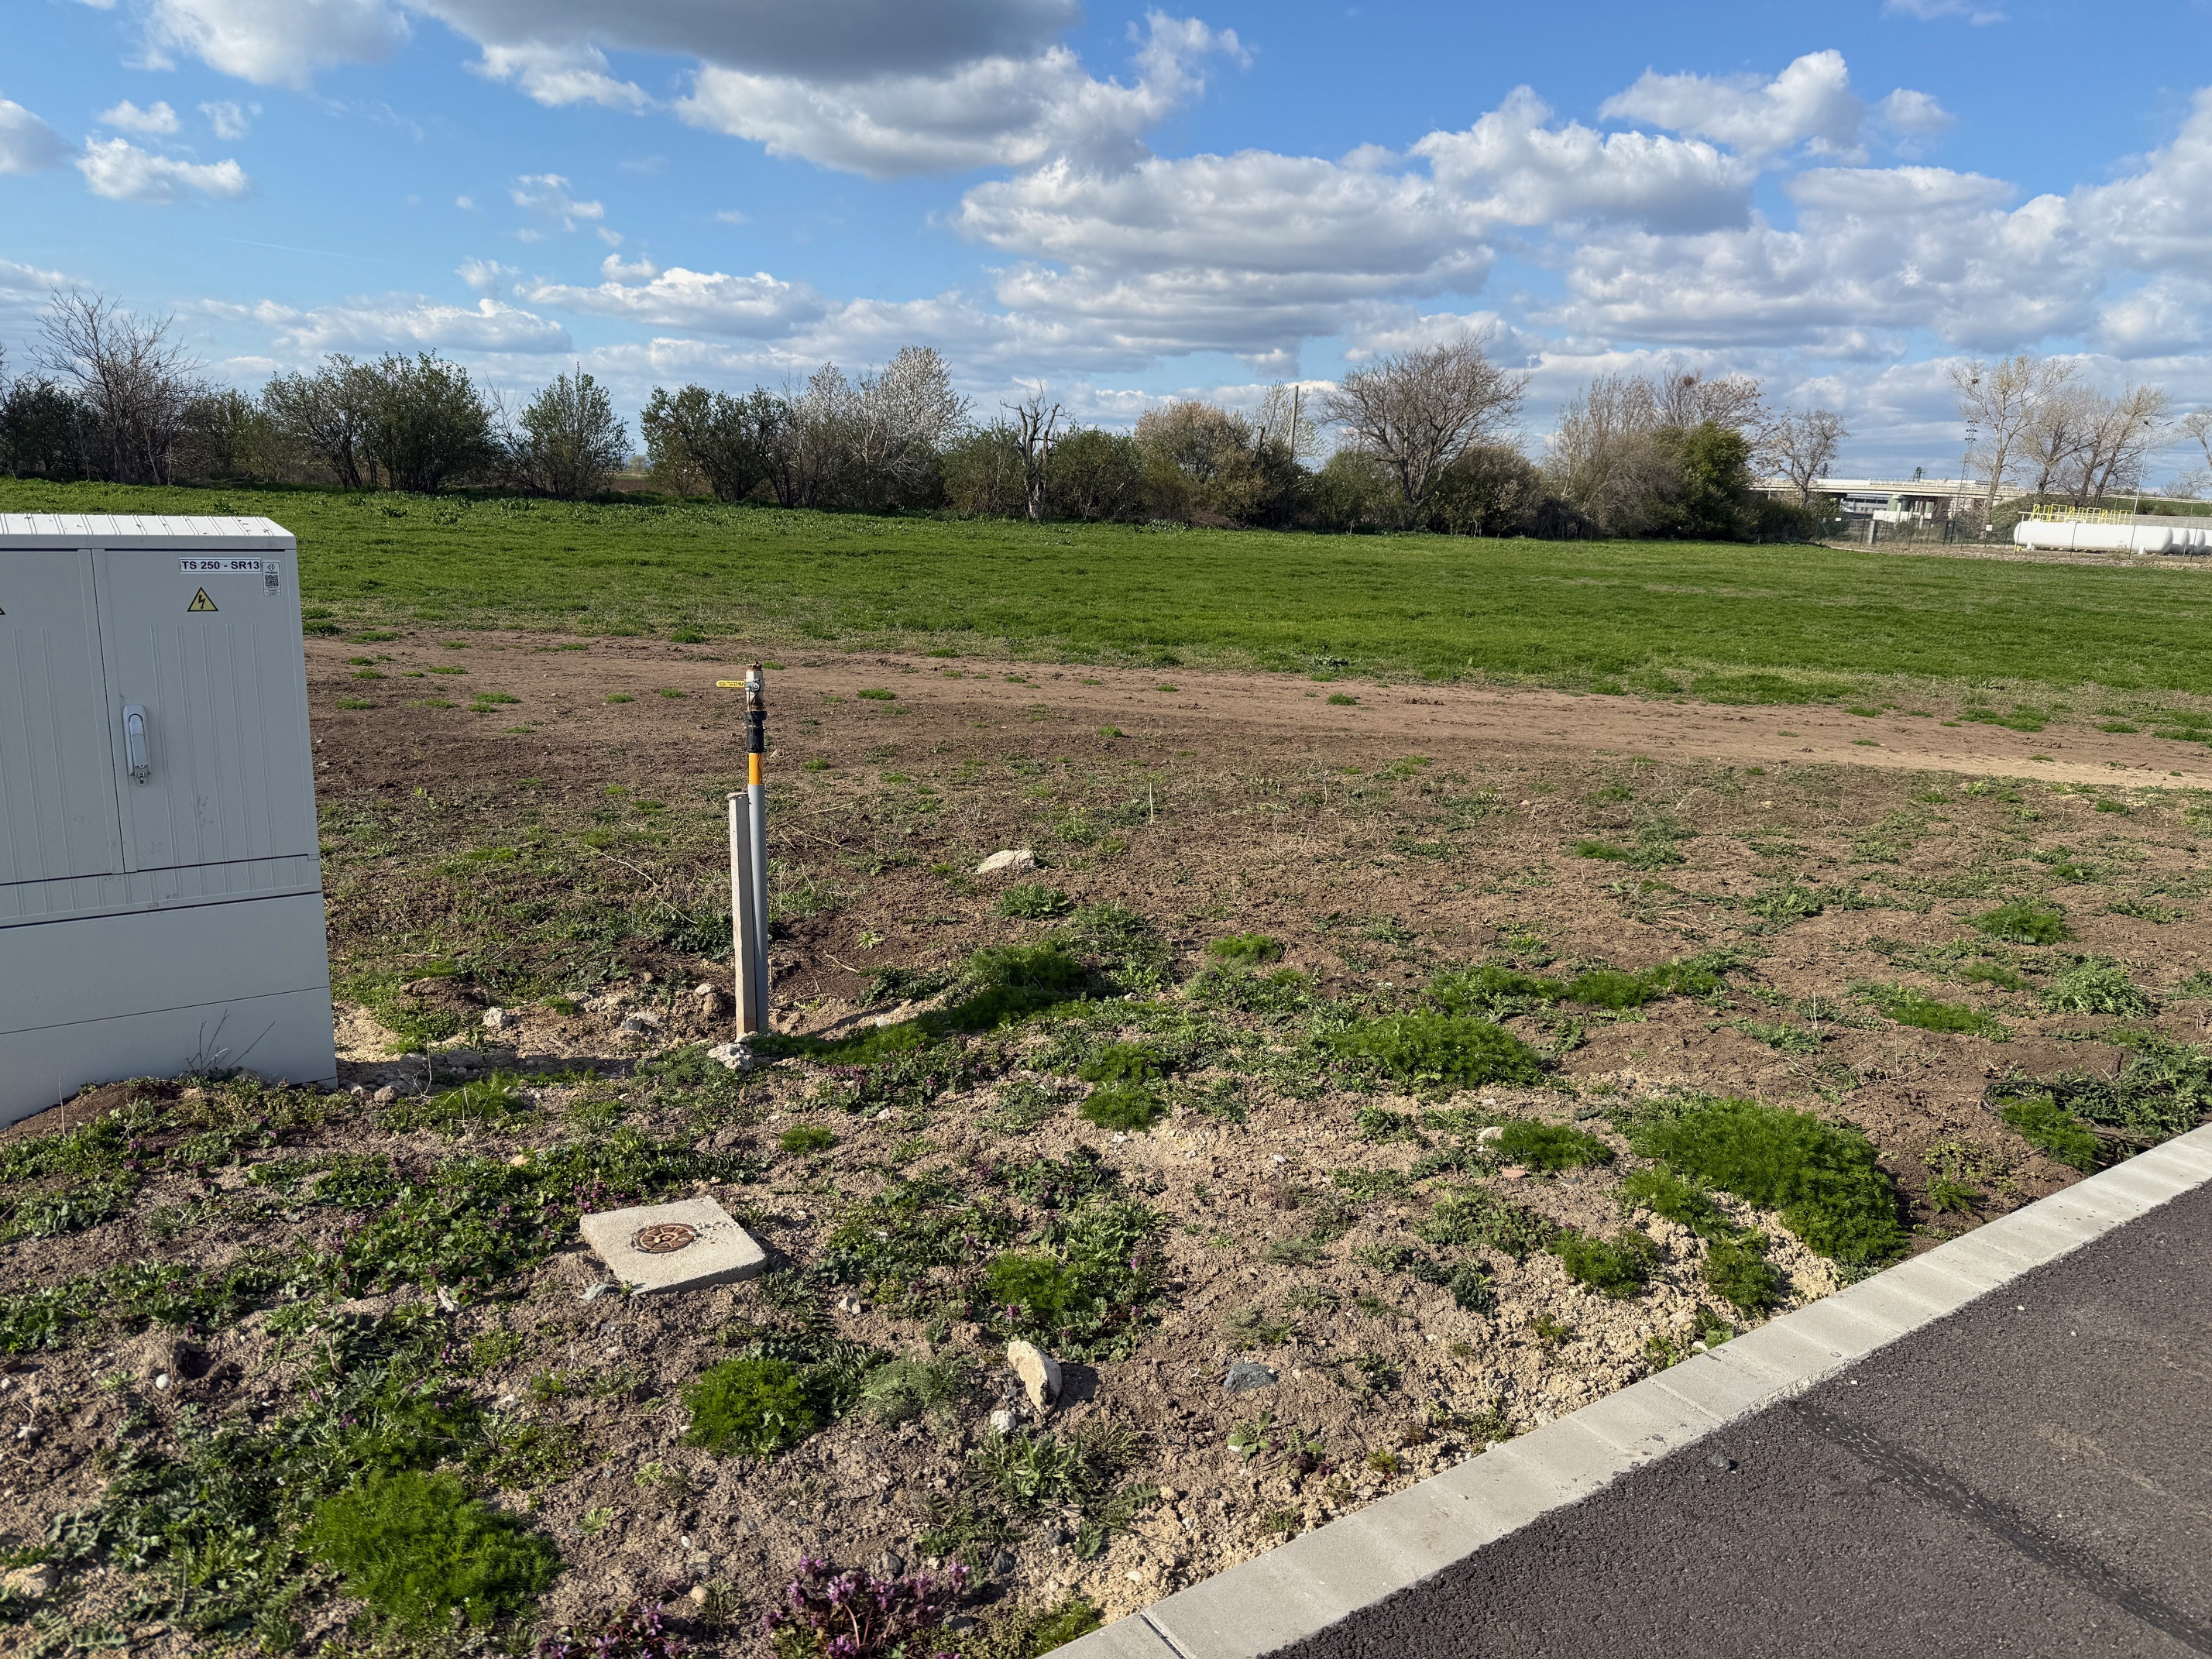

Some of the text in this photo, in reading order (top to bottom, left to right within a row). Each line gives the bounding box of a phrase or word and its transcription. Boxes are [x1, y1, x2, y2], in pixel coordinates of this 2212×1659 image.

[181, 561, 198, 569] TS
[201, 561, 220, 569] 250
[231, 561, 259, 569] SR13
